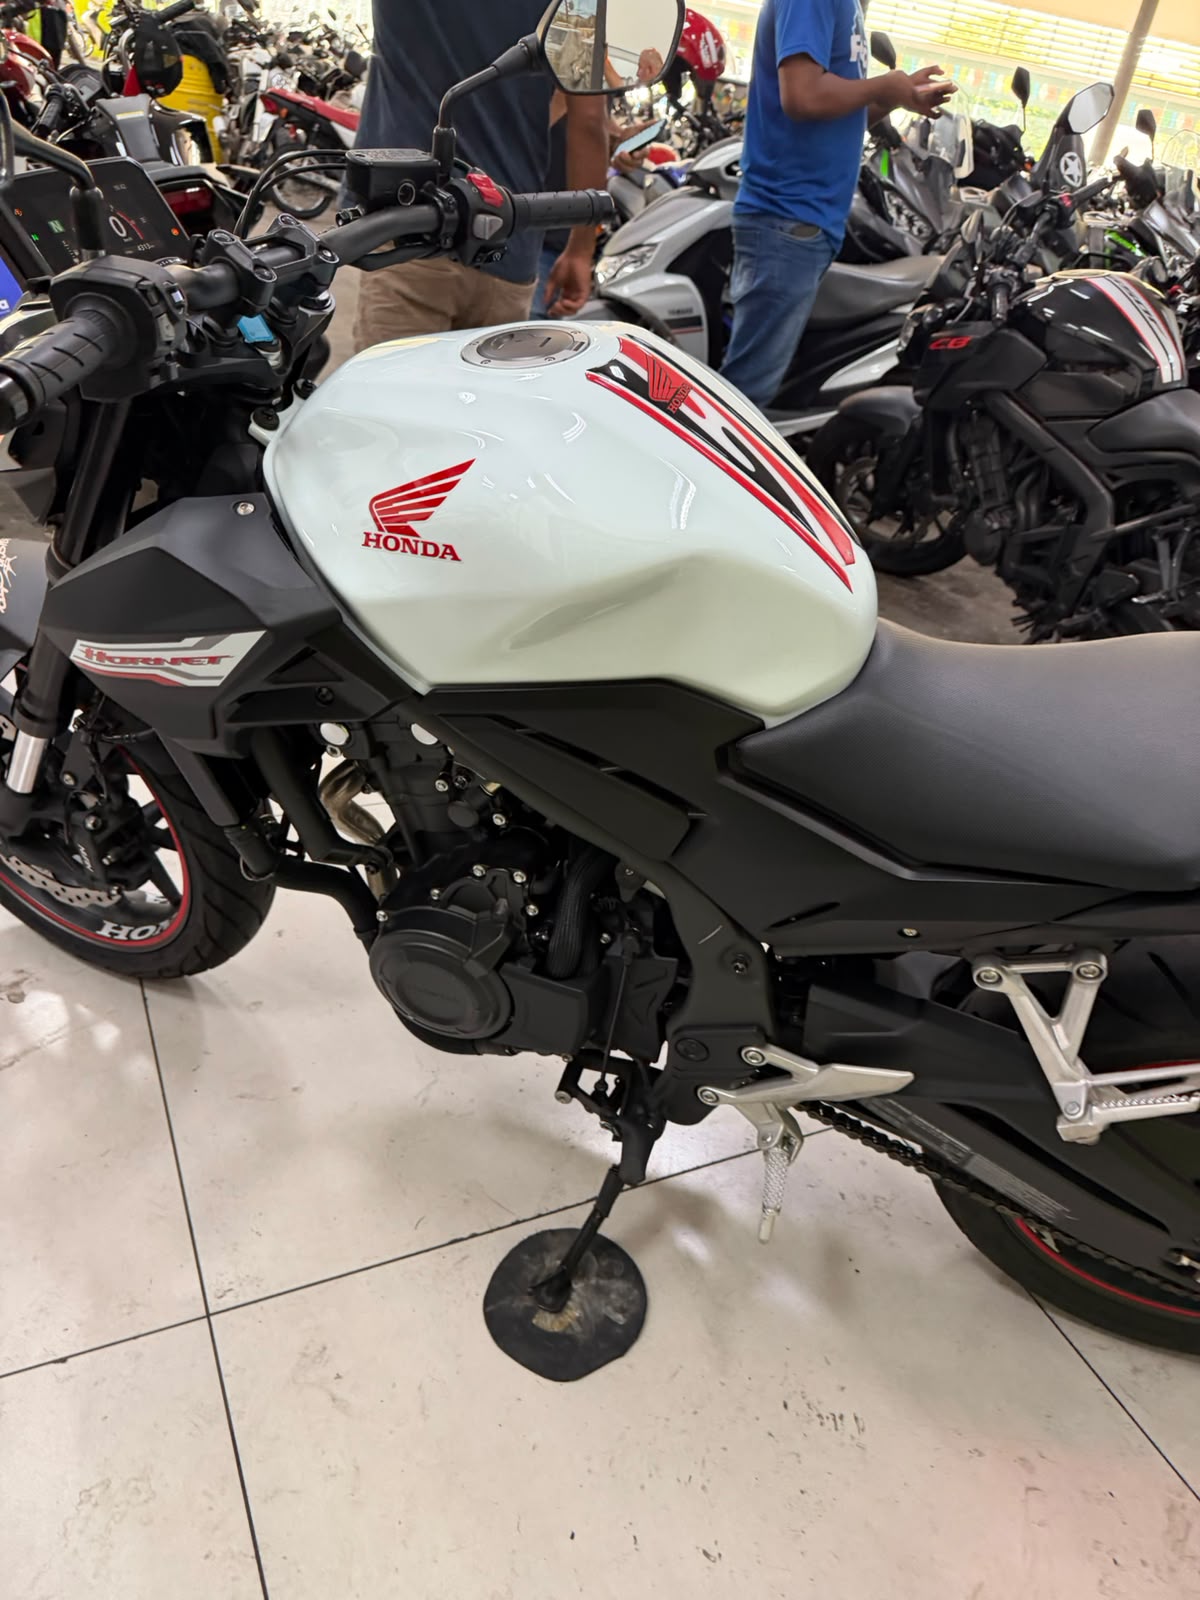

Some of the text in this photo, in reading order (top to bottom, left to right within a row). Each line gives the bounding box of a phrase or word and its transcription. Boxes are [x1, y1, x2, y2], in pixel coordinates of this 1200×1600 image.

[109, 216, 127, 237] 0
[929, 336, 973, 349] CB
[667, 382, 692, 415] HONDA
[361, 531, 463, 562] HONDA
[84, 648, 234, 666] HORNET
